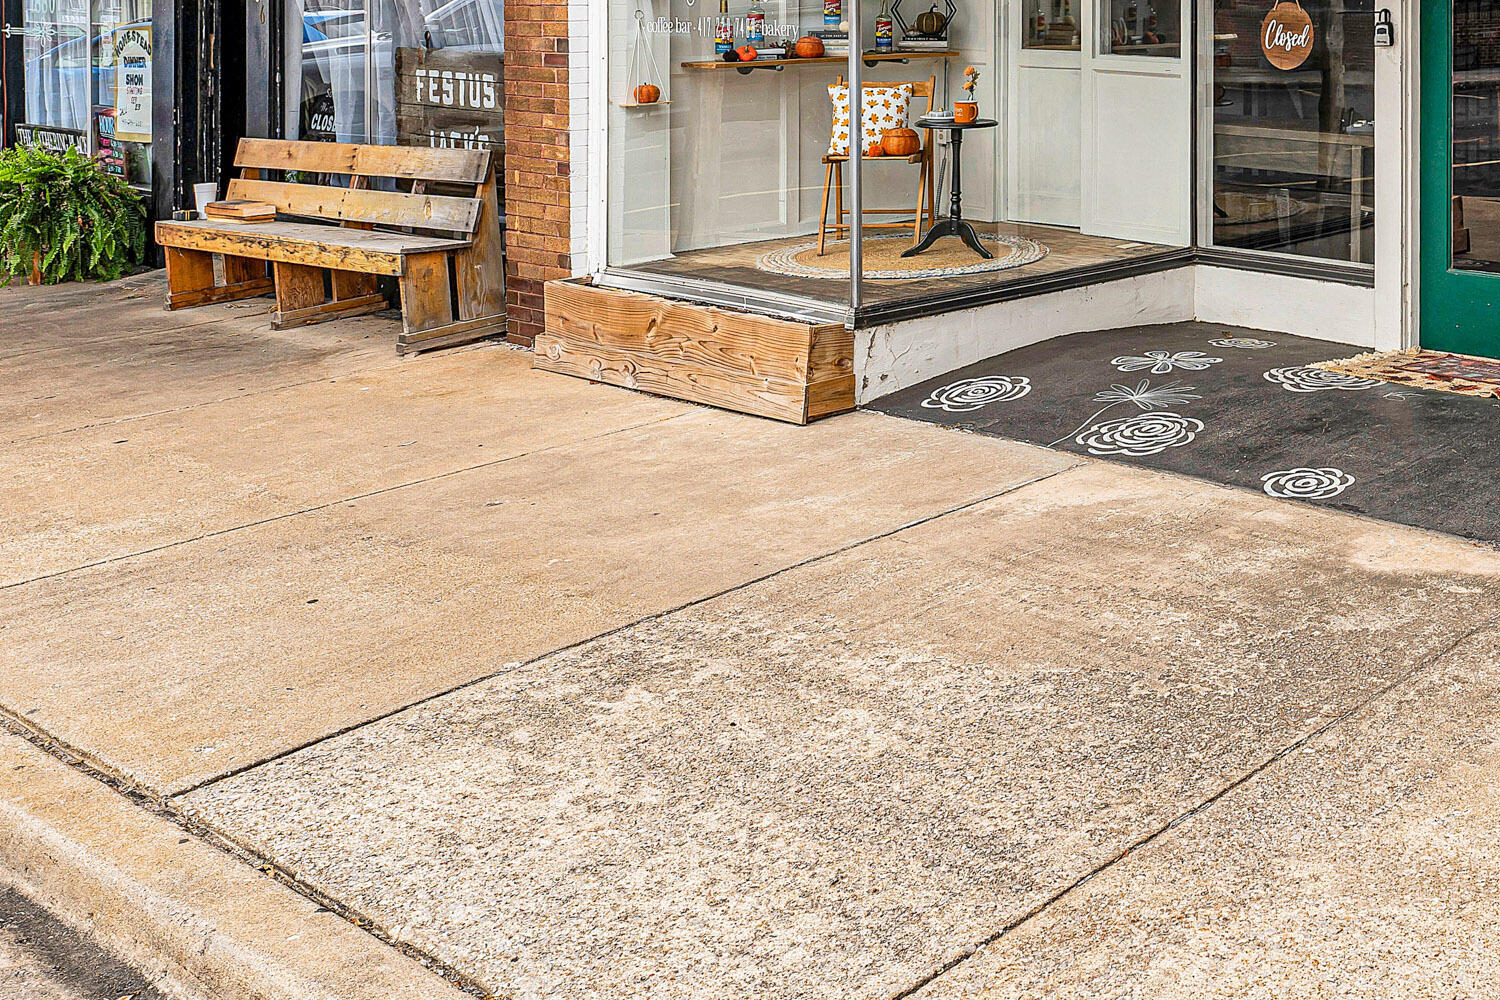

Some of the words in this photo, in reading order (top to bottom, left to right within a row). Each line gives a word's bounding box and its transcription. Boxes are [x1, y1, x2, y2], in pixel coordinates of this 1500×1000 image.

[647, 15, 673, 35] coffee
[675, 16, 693, 34] bar
[761, 17, 799, 42] bakery
[1264, 19, 1311, 52] Closed
[114, 30, 152, 58] HOMESTEAD
[415, 68, 496, 110] FESTUS
[311, 113, 337, 133] CLOSE
[17, 127, 32, 147] THE
